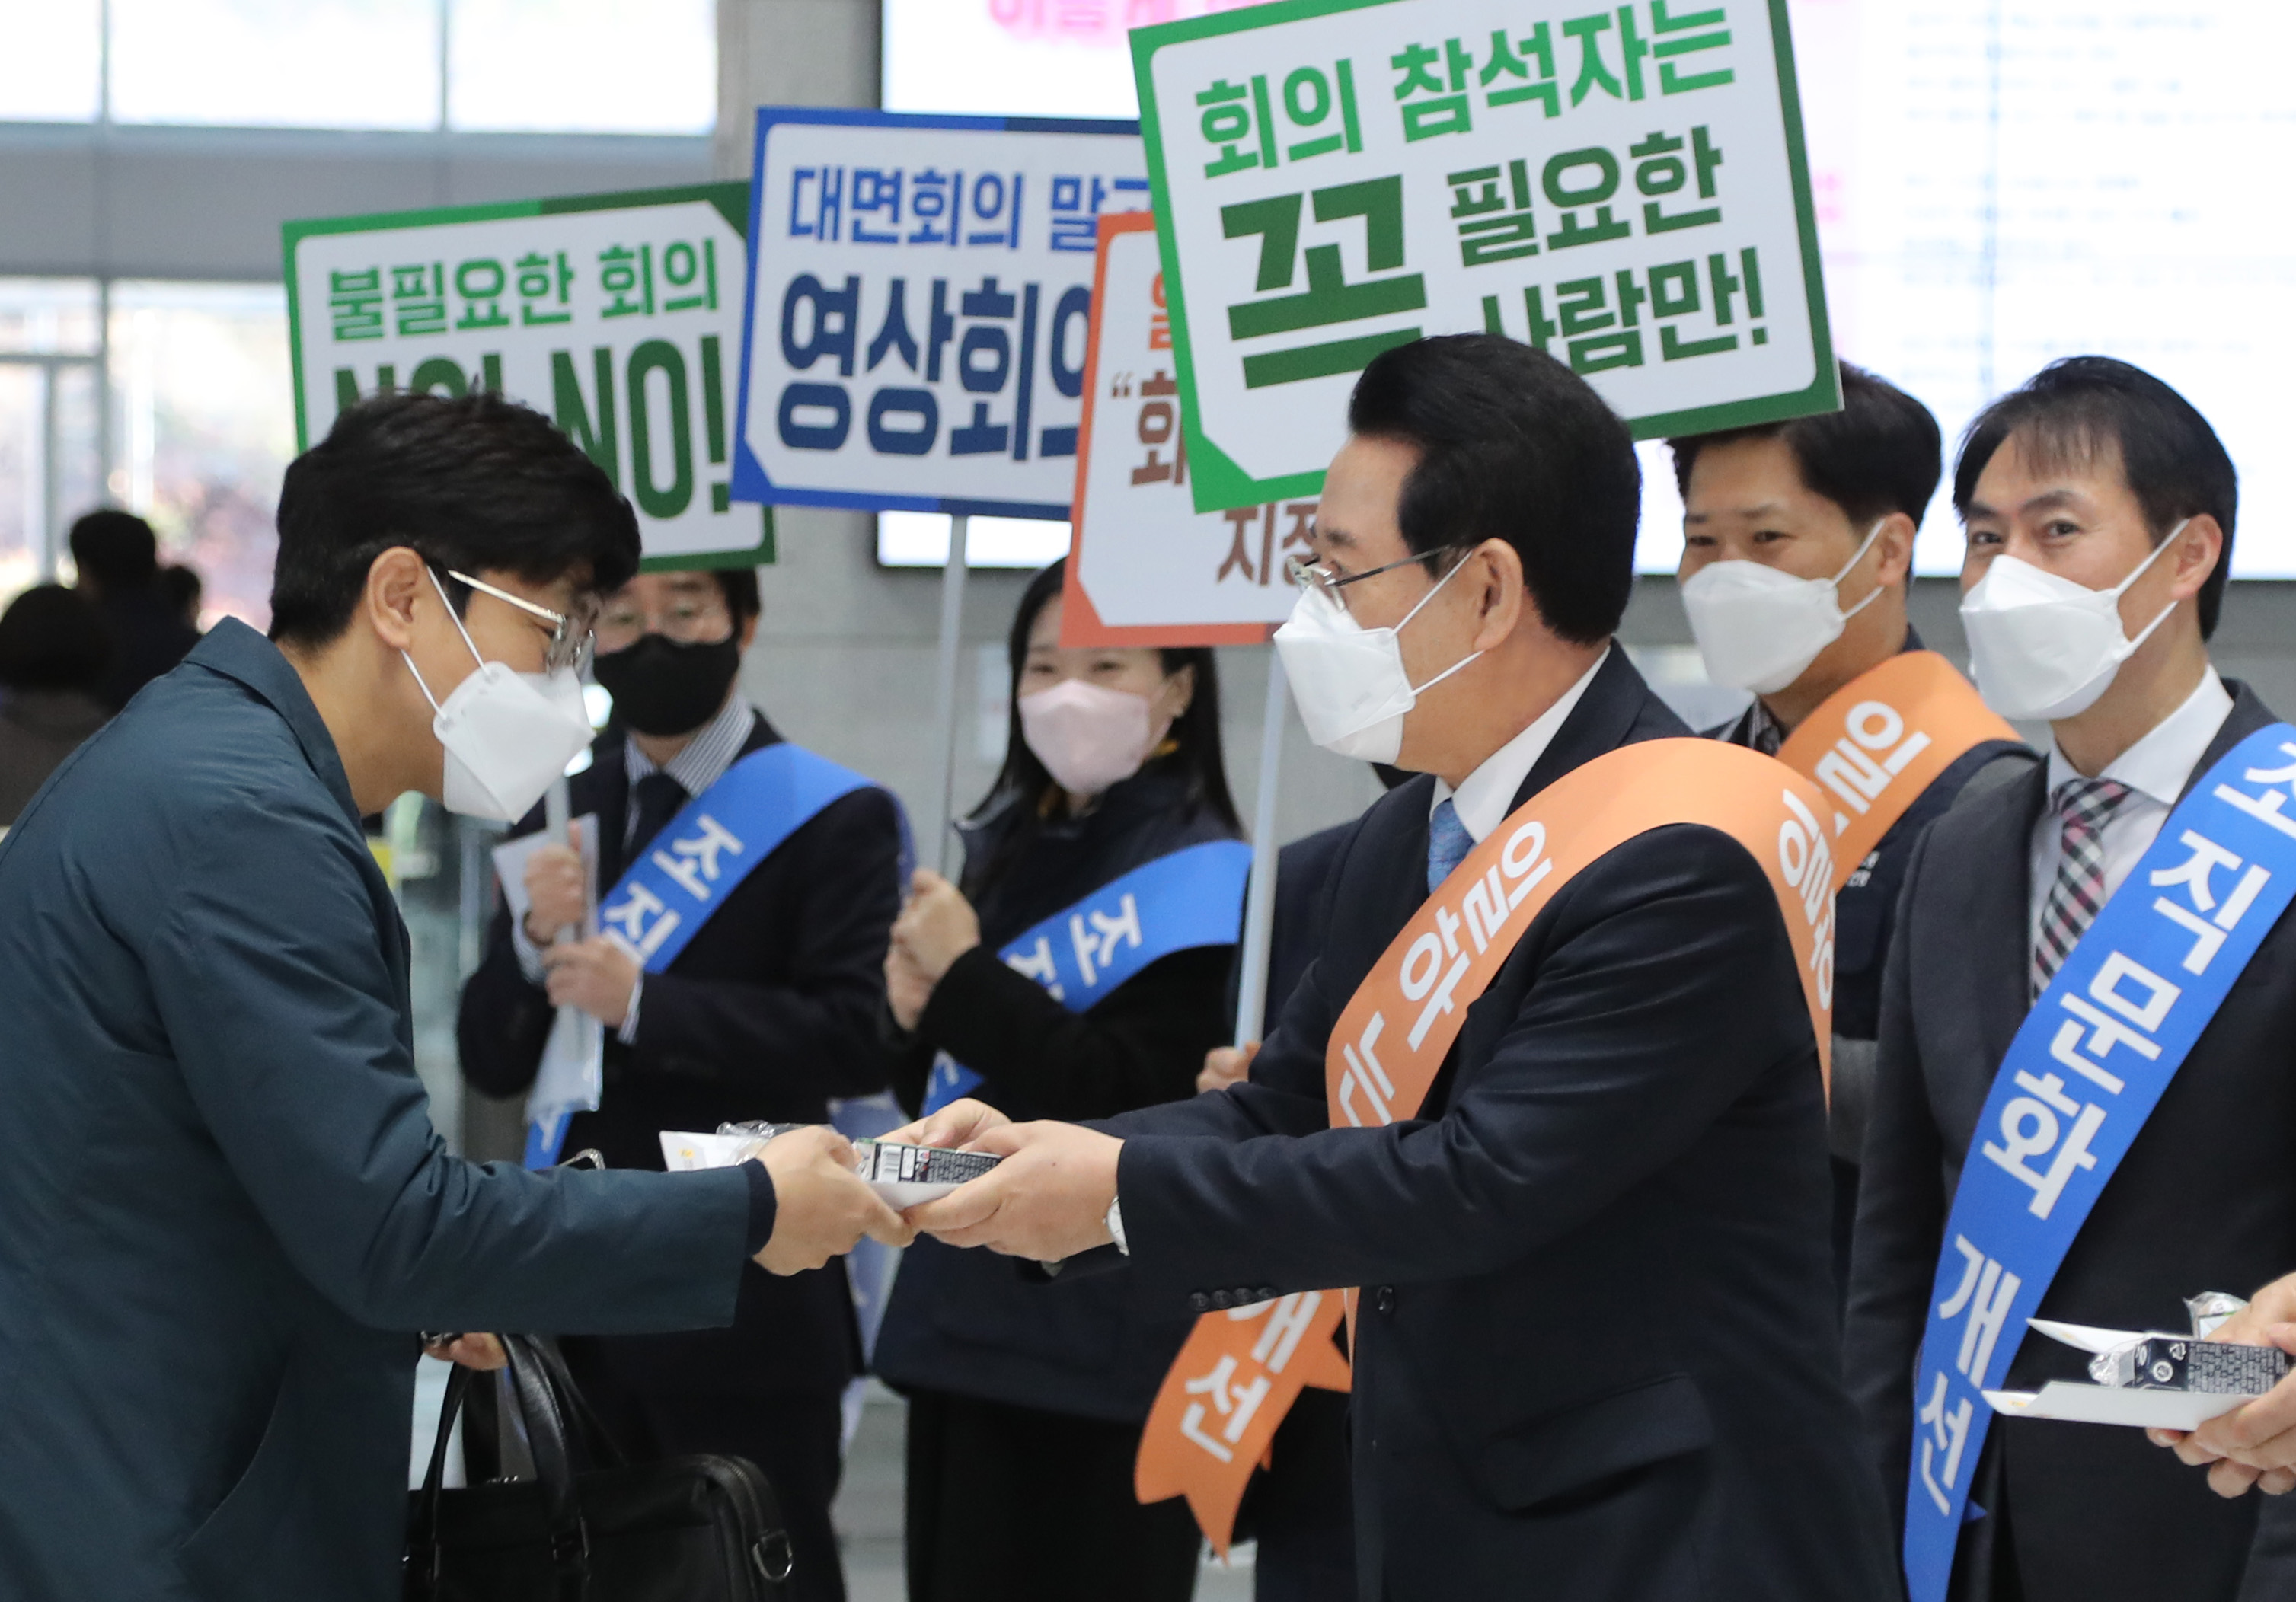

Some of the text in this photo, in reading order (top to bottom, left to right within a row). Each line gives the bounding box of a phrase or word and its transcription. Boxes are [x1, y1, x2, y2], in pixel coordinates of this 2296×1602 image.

[1195, 0, 1735, 179] 회의 참석자는
[787, 164, 1023, 250] 대면회의
[1220, 174, 1428, 391] 꼭
[1447, 126, 1723, 268] 필요한
[328, 236, 718, 342] 불필요한 회의
[551, 334, 730, 520] NO!
[1921, 1234, 2022, 1517] 개선
